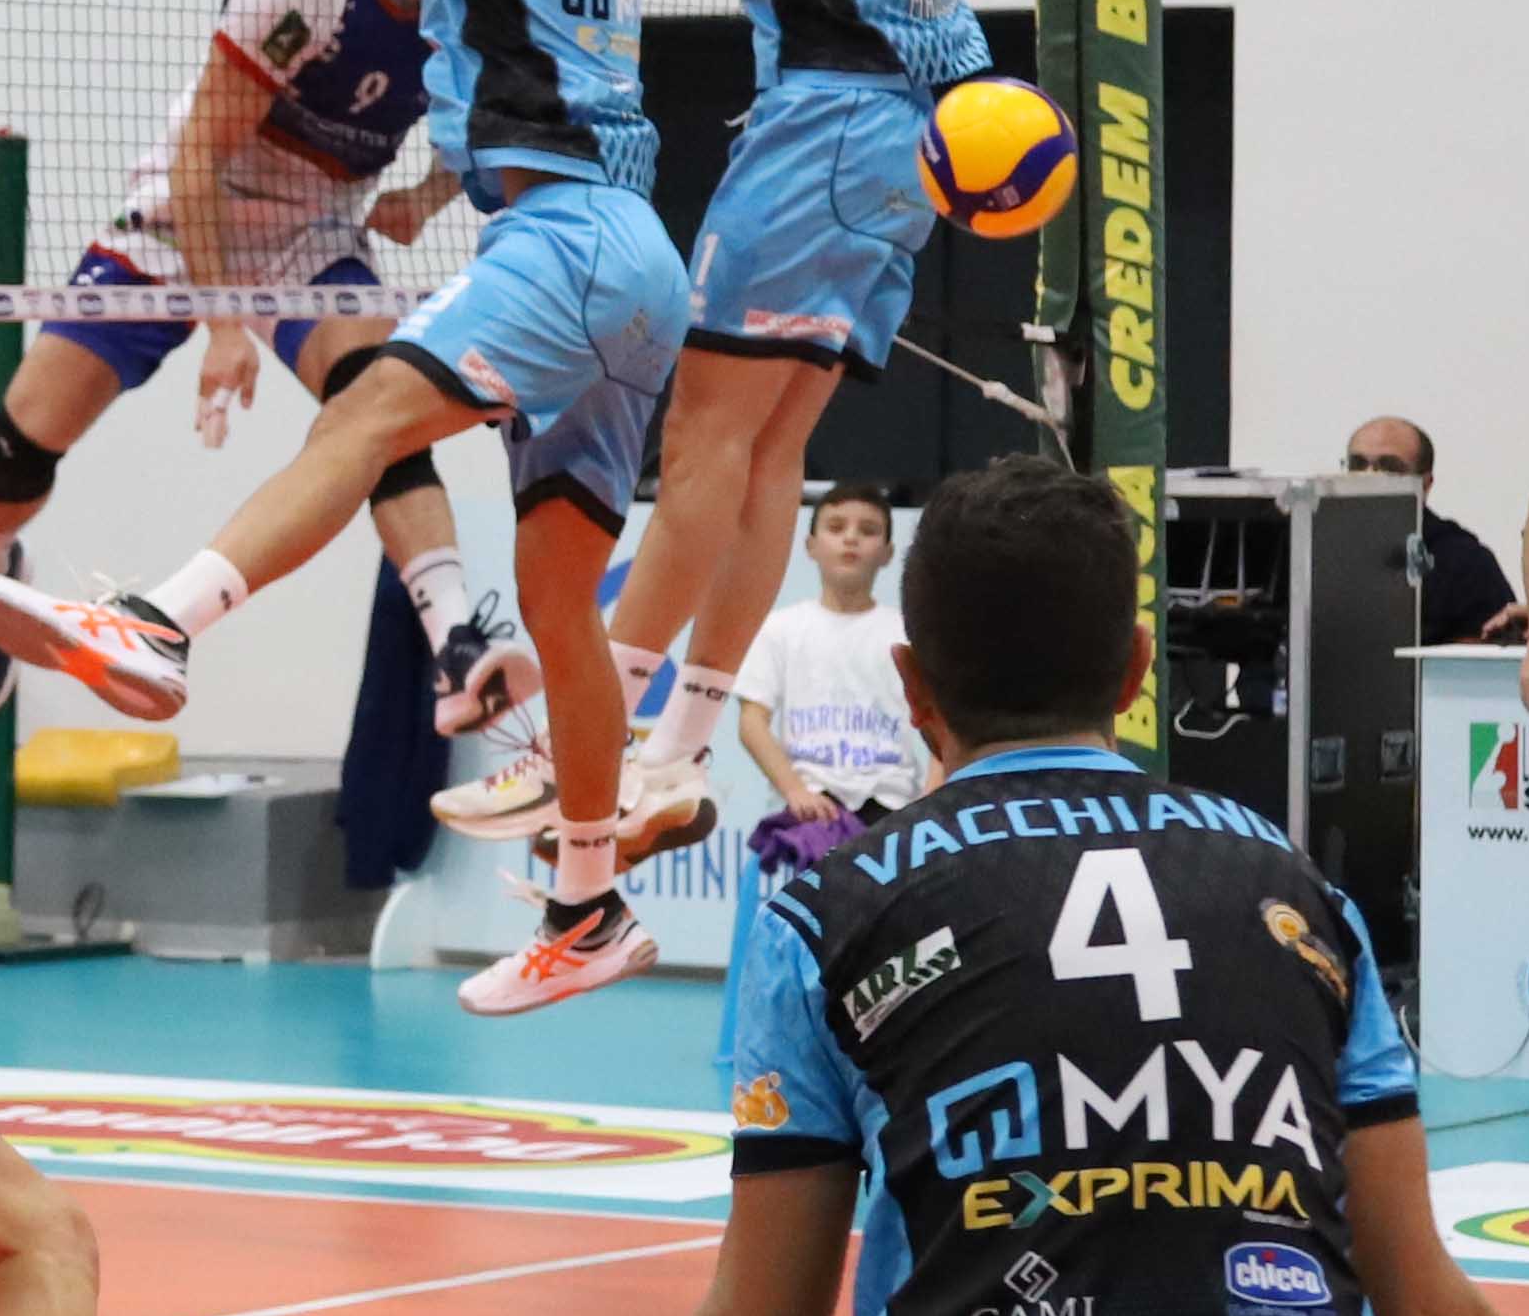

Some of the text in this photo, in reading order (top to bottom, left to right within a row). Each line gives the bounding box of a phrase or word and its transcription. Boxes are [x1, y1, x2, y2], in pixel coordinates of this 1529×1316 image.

[349, 69, 390, 115] 9
[1100, 85, 1151, 411] CREDEM
[854, 792, 1293, 885] VACCHIANO
[1048, 847, 1193, 1022] 4
[1057, 1039, 1324, 1172] MYA
[961, 1161, 1311, 1230] EXPRIMA
[1235, 1254, 1322, 1294] chicco
